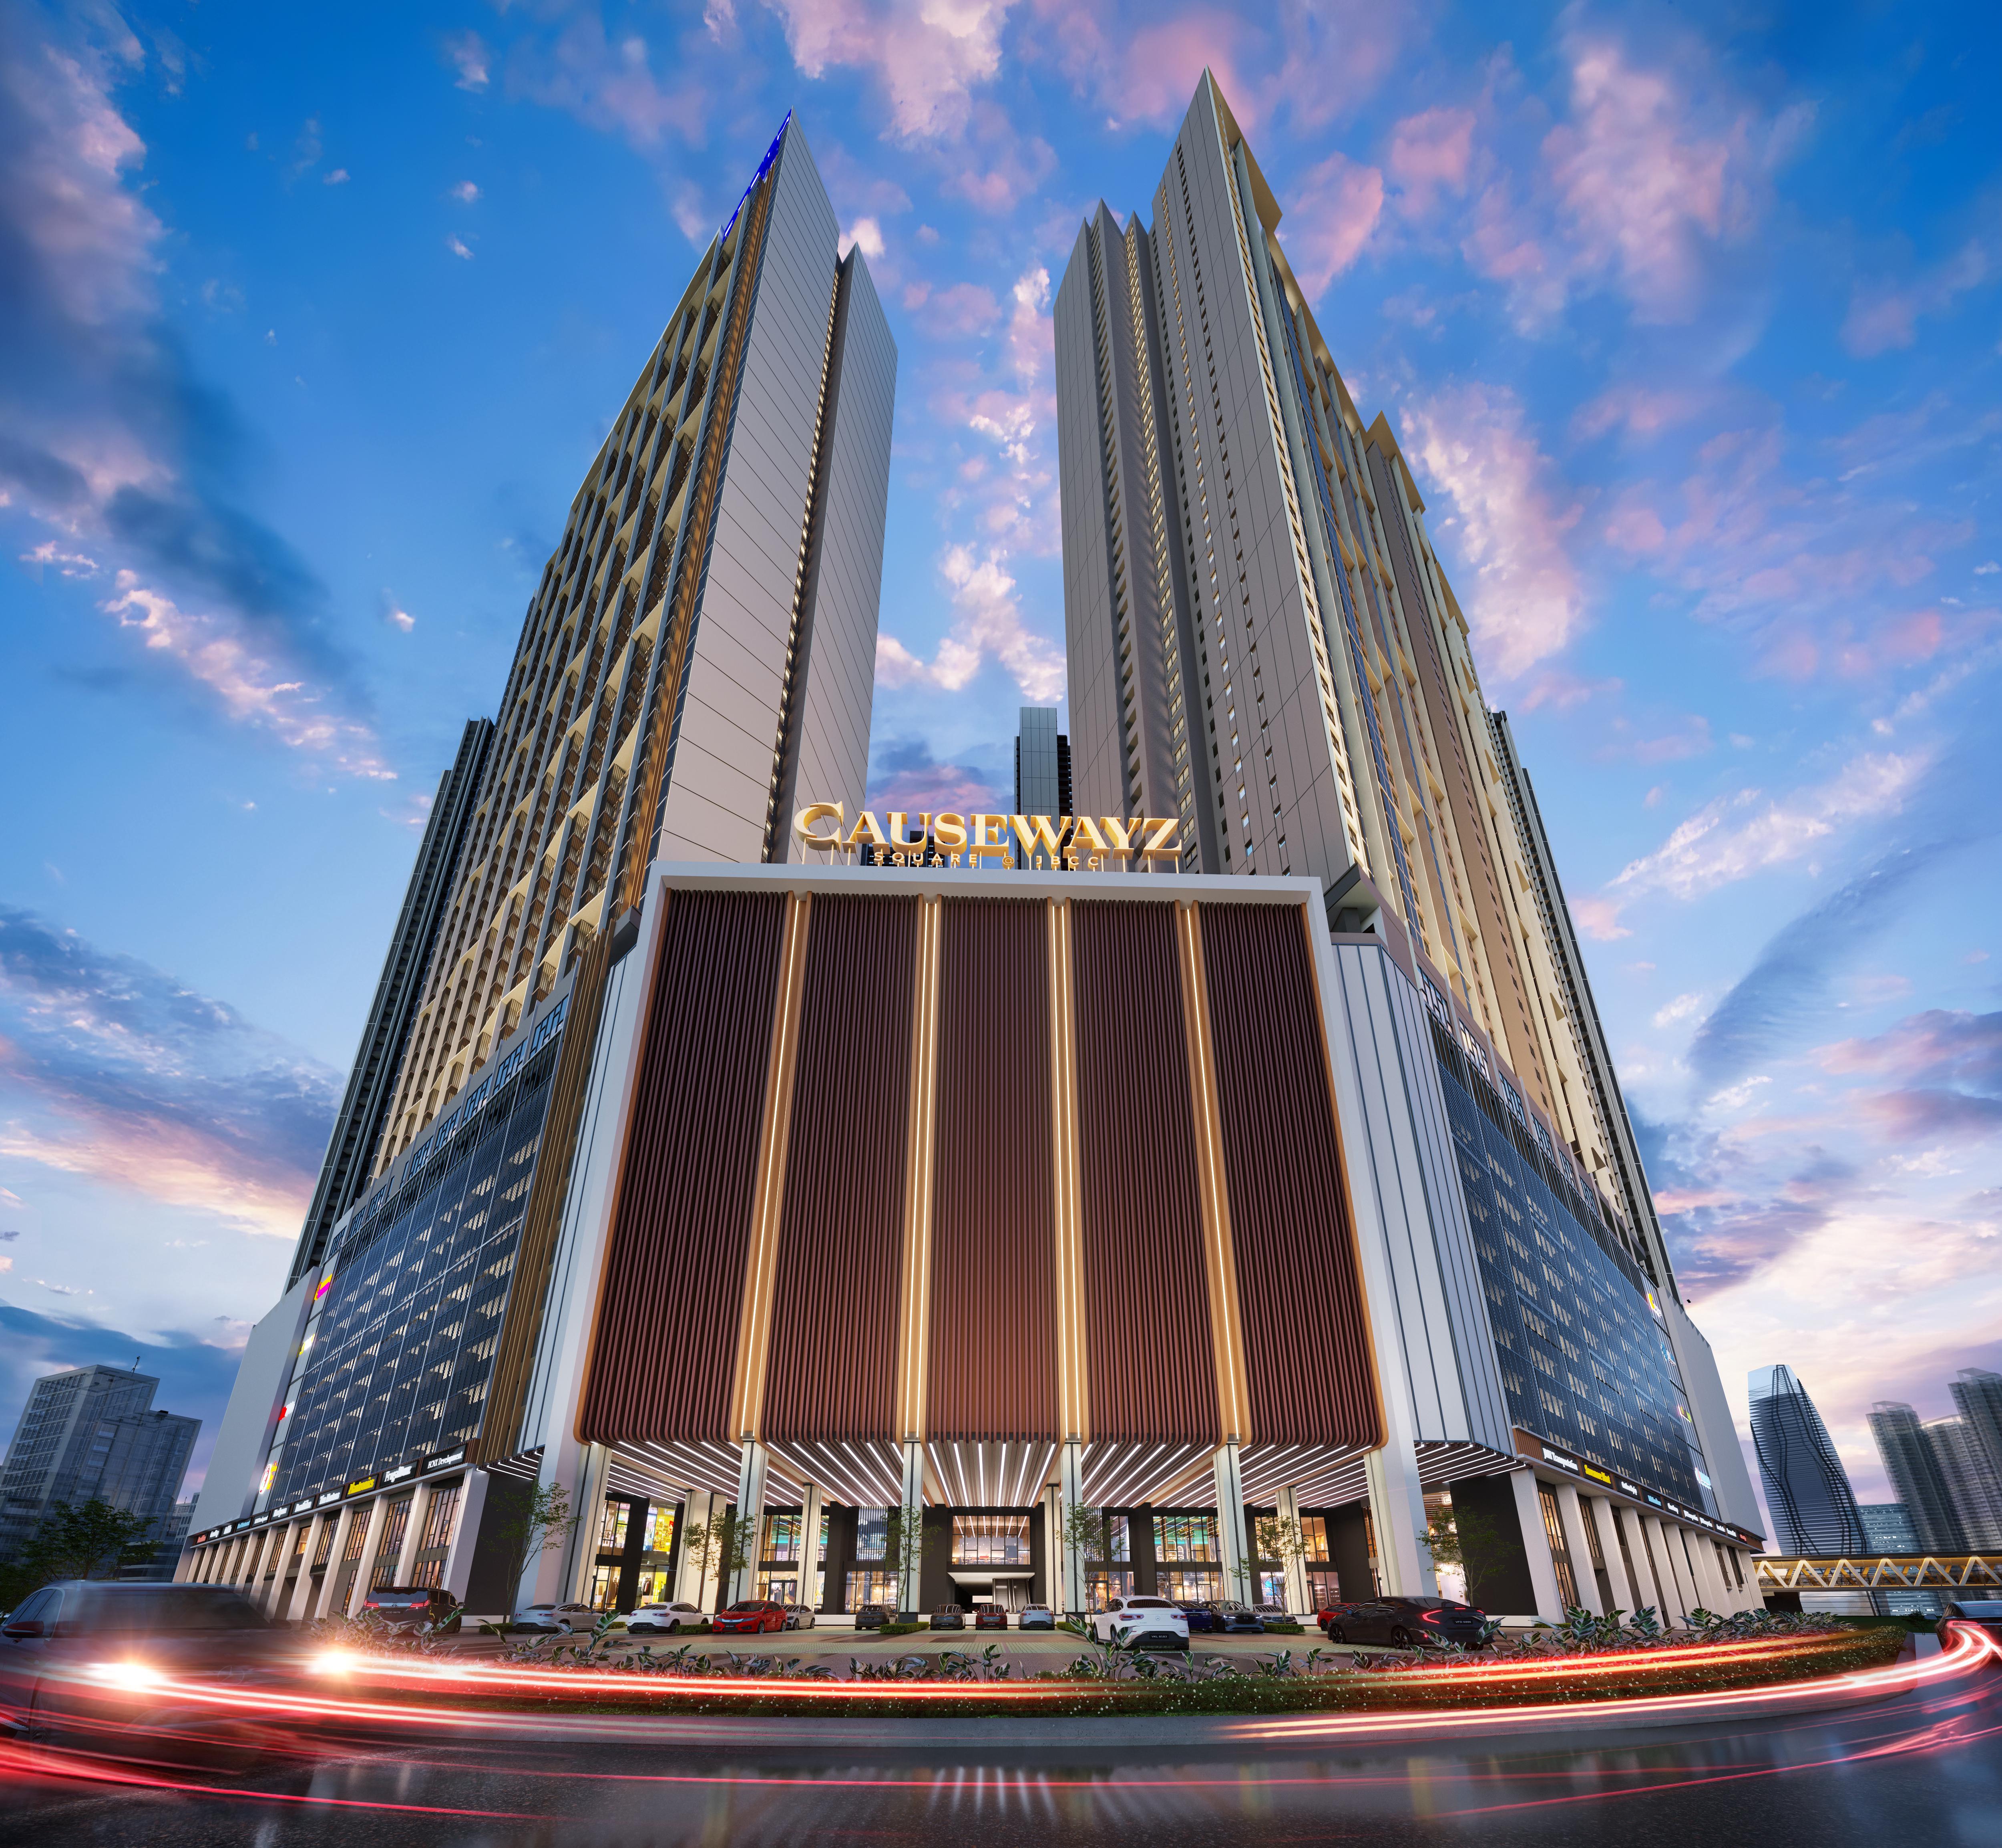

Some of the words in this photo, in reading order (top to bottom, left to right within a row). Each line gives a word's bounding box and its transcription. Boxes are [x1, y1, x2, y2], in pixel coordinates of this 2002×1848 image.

[794, 801, 1182, 861] CAUSEWAYZ
[874, 852, 977, 867] SQUARE
[1002, 856, 1015, 870] @
[1036, 856, 1099, 870] JBCC
